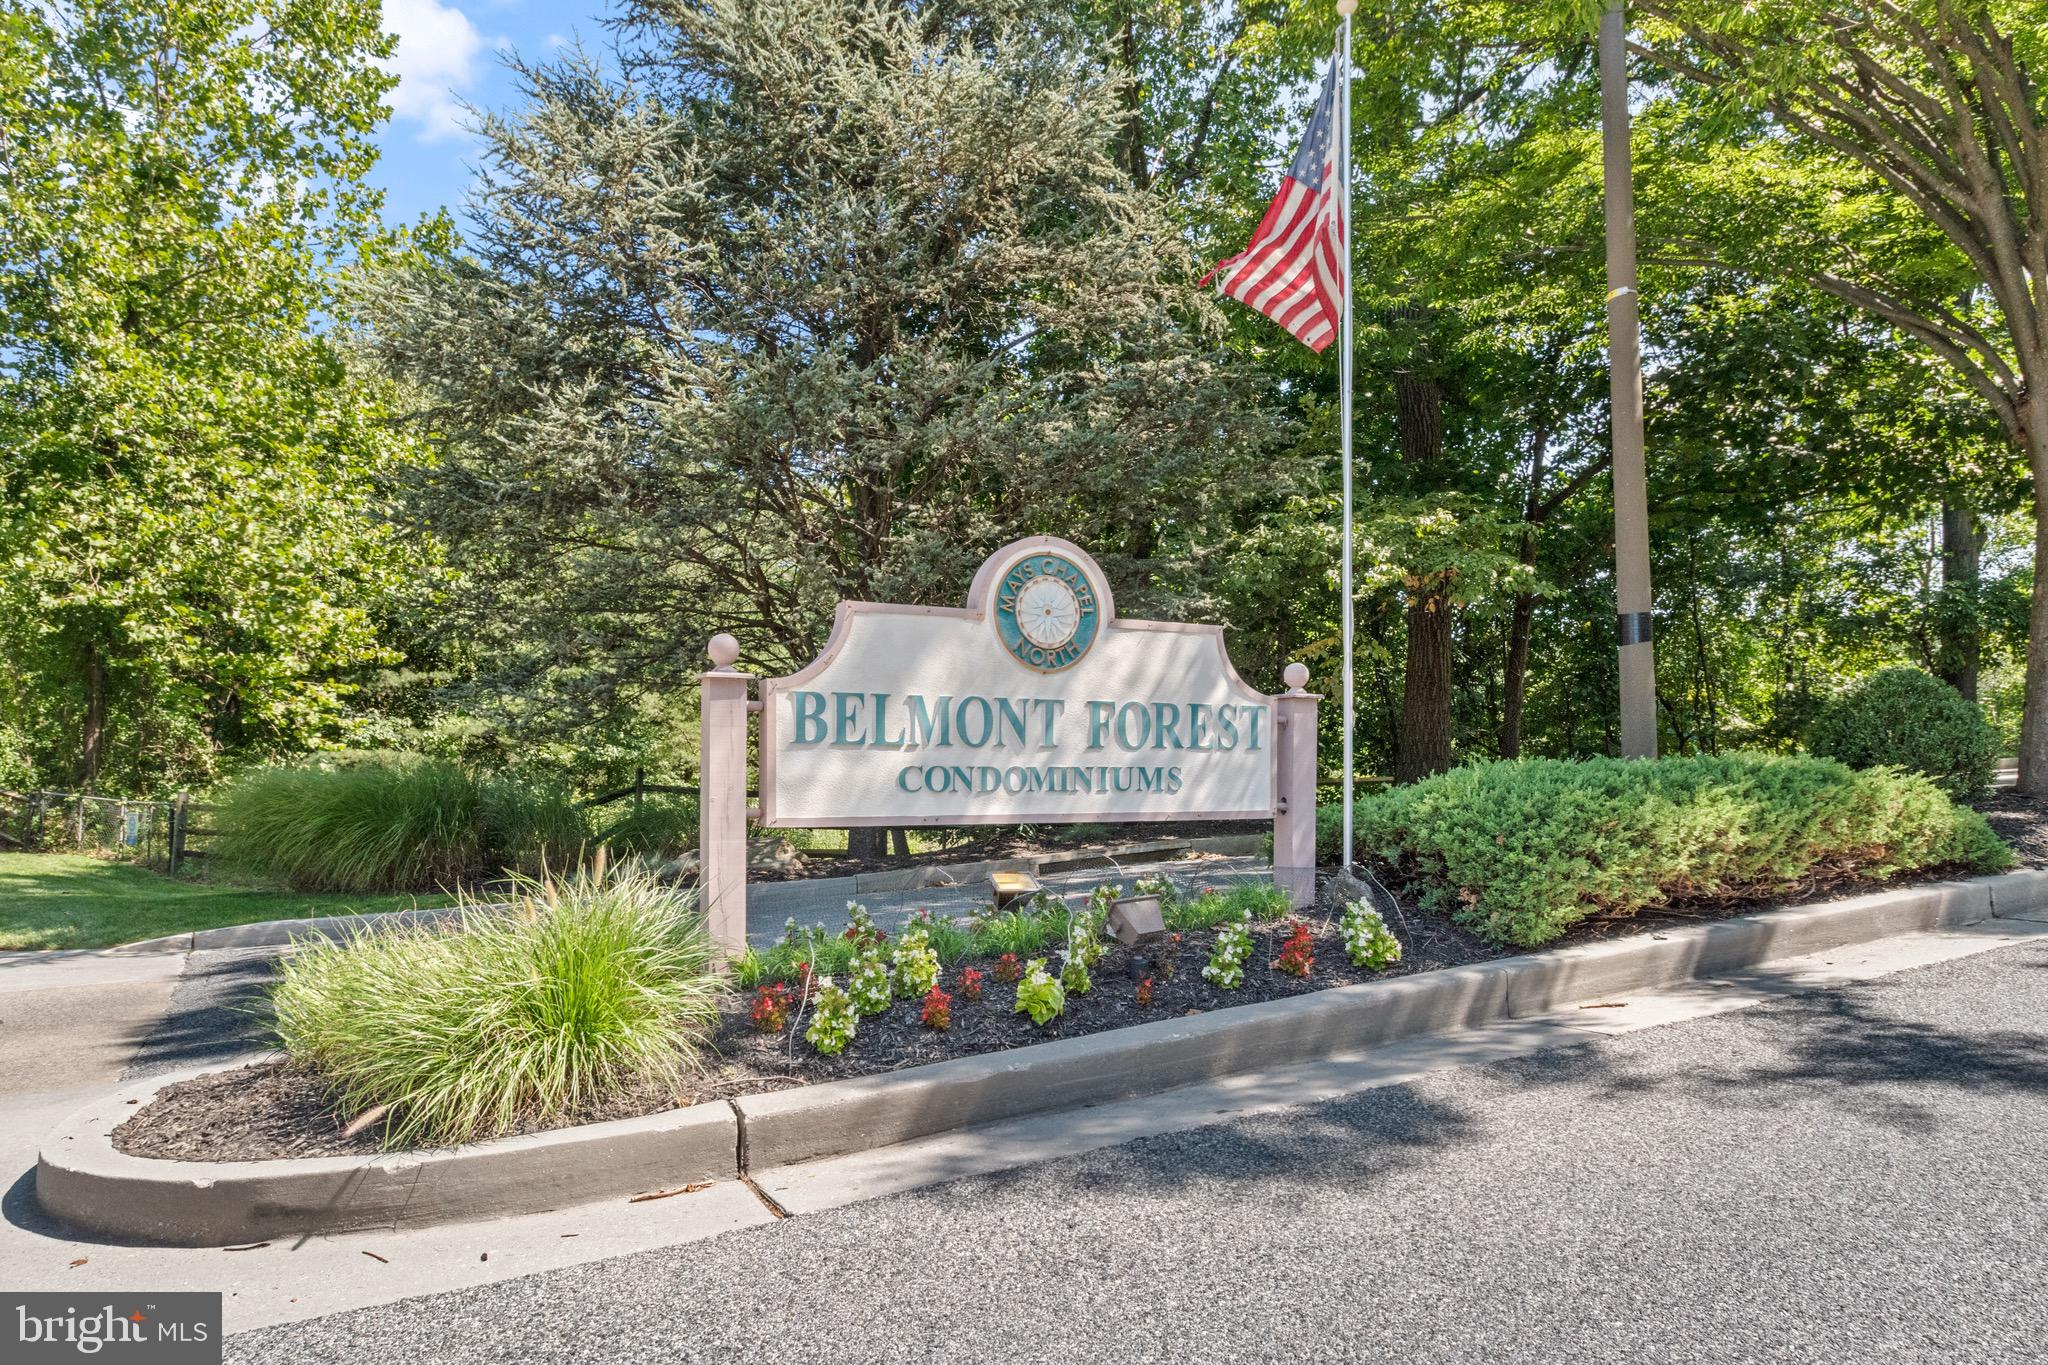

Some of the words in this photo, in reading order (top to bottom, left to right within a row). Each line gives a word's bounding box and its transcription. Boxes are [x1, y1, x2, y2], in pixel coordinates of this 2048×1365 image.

[1000, 562, 1034, 613] MAYS
[1041, 558, 1094, 617] CHAPEL
[1014, 638, 1080, 665] NORTH
[790, 690, 1064, 751] BELMONT
[1086, 699, 1267, 752] FOREST
[898, 764, 1183, 794] CONDOMINIUMS
